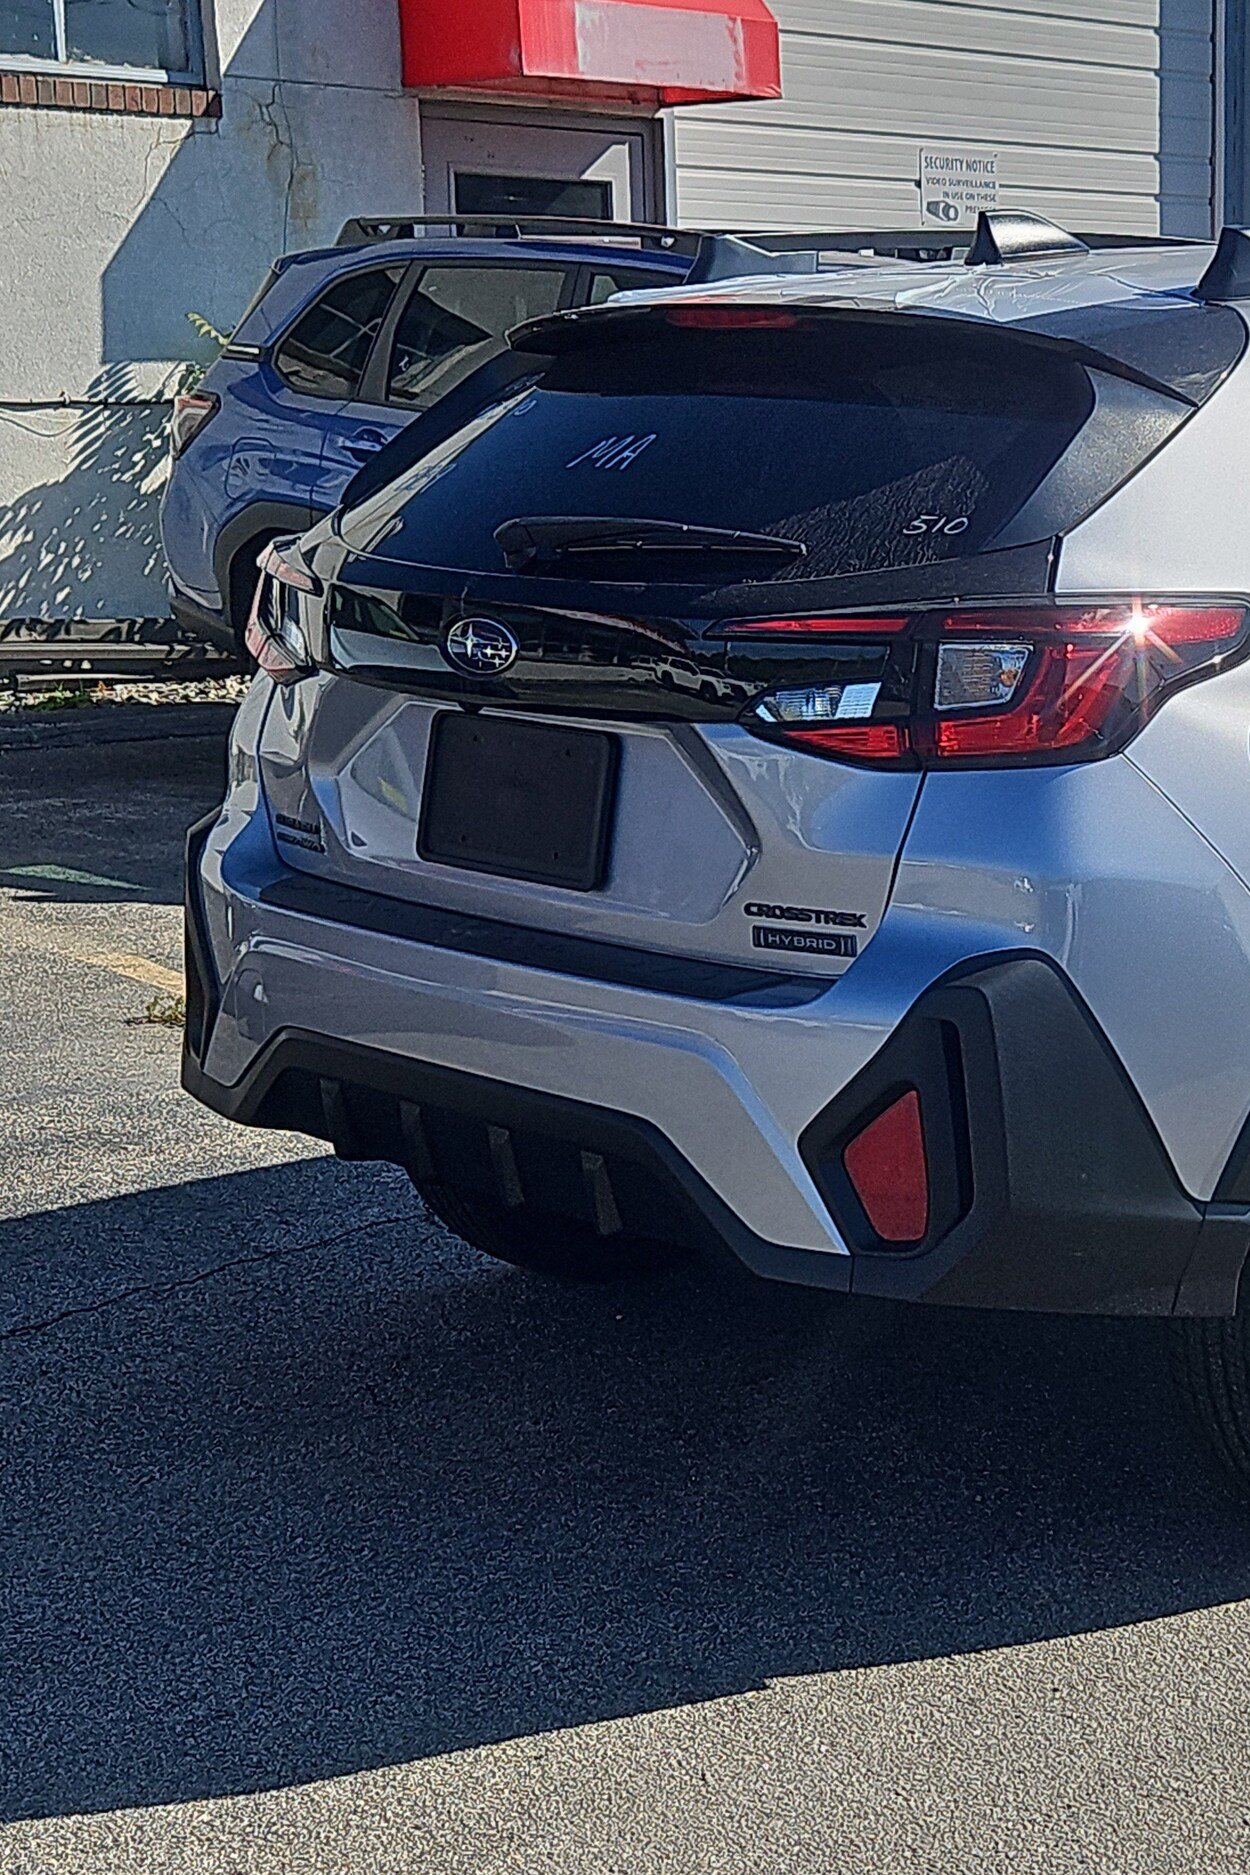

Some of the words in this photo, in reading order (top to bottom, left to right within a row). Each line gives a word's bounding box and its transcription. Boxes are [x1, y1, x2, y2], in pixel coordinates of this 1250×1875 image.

[924, 155, 963, 172] SECURITY
[966, 159, 995, 174] NOTICE
[925, 176, 947, 186] VIDEO
[948, 178, 996, 190] SURVEILLANCE
[942, 190, 950, 199] IN
[951, 191, 964, 201] USE
[965, 192, 975, 201] ON
[976, 193, 997, 203] THESE
[902, 514, 969, 535] 510
[743, 901, 868, 929] CROSSTREK
[767, 933, 837, 951] HYBRID
